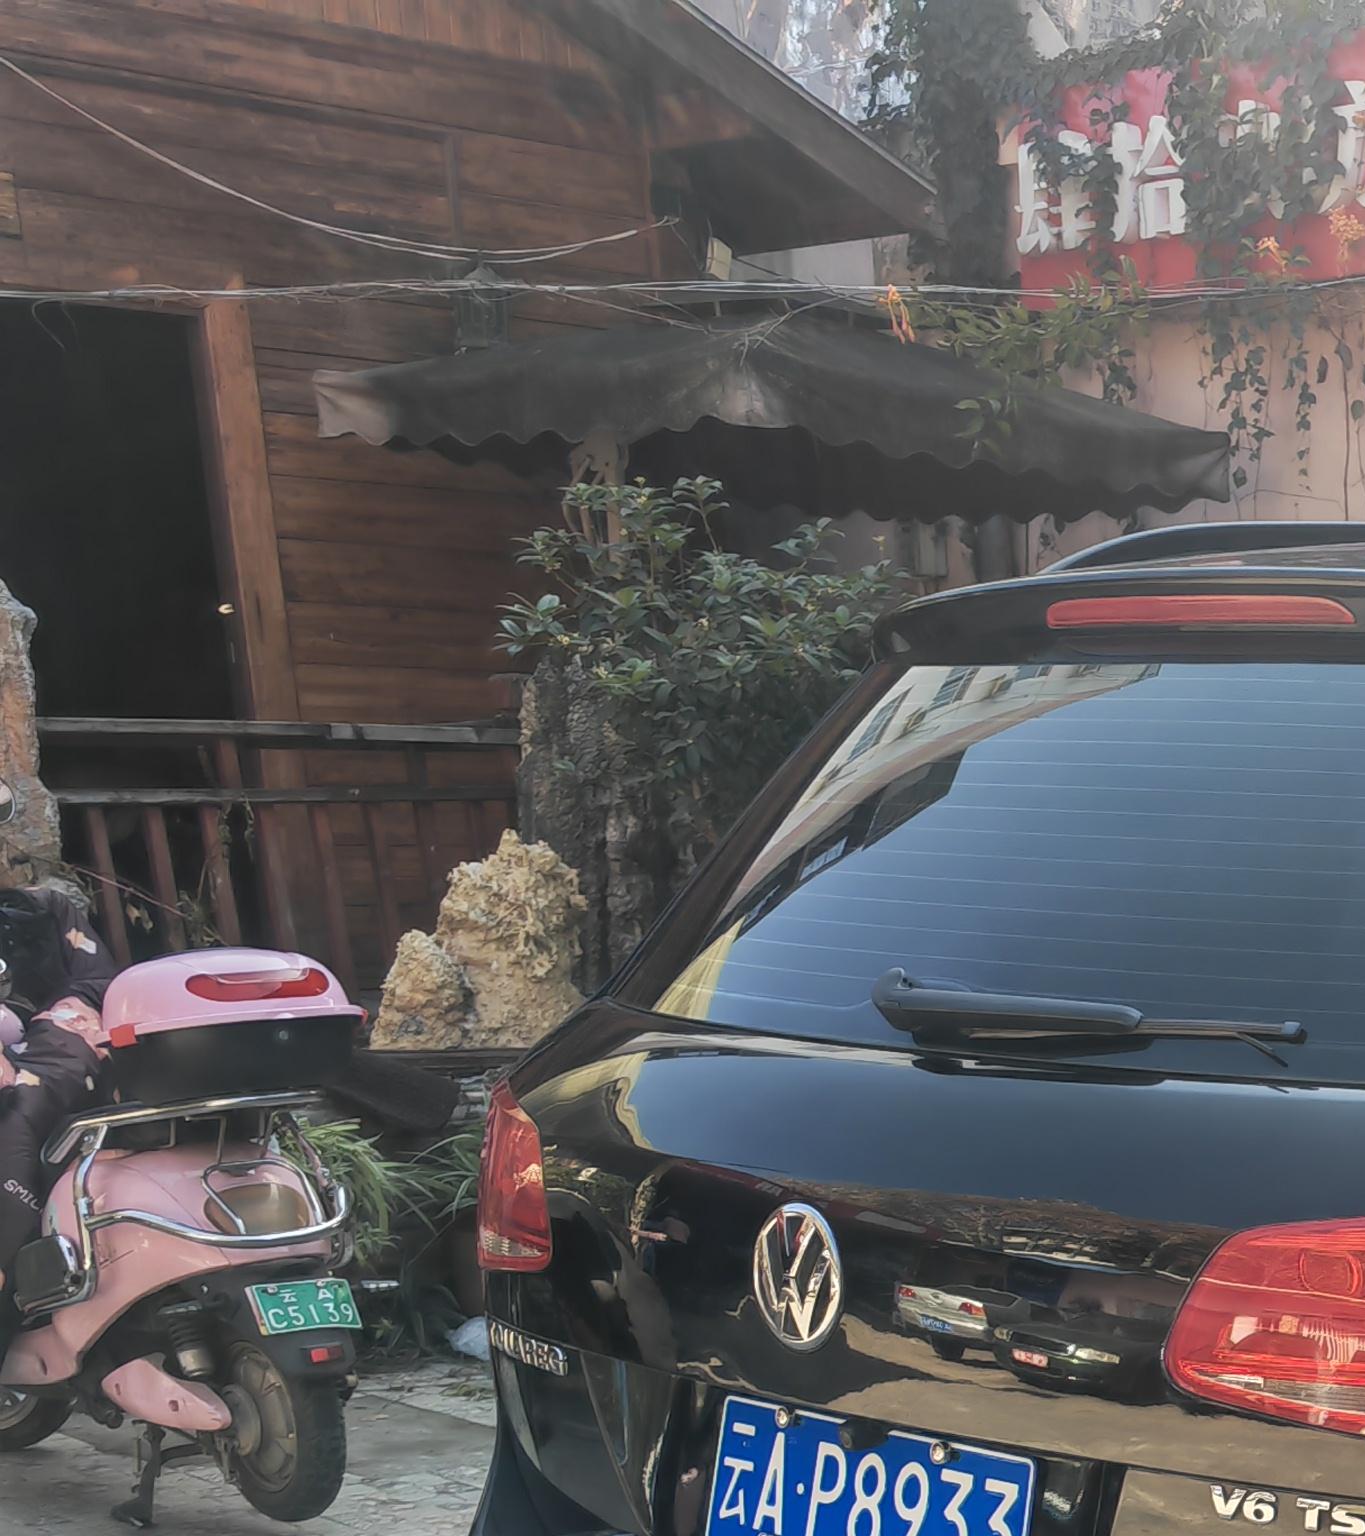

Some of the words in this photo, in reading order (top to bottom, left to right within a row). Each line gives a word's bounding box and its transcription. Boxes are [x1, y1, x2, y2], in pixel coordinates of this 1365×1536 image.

[4, 1179, 43, 1214] SMIL
[267, 1302, 354, 1329] C5139
[1210, 1485, 1276, 1524] V6
